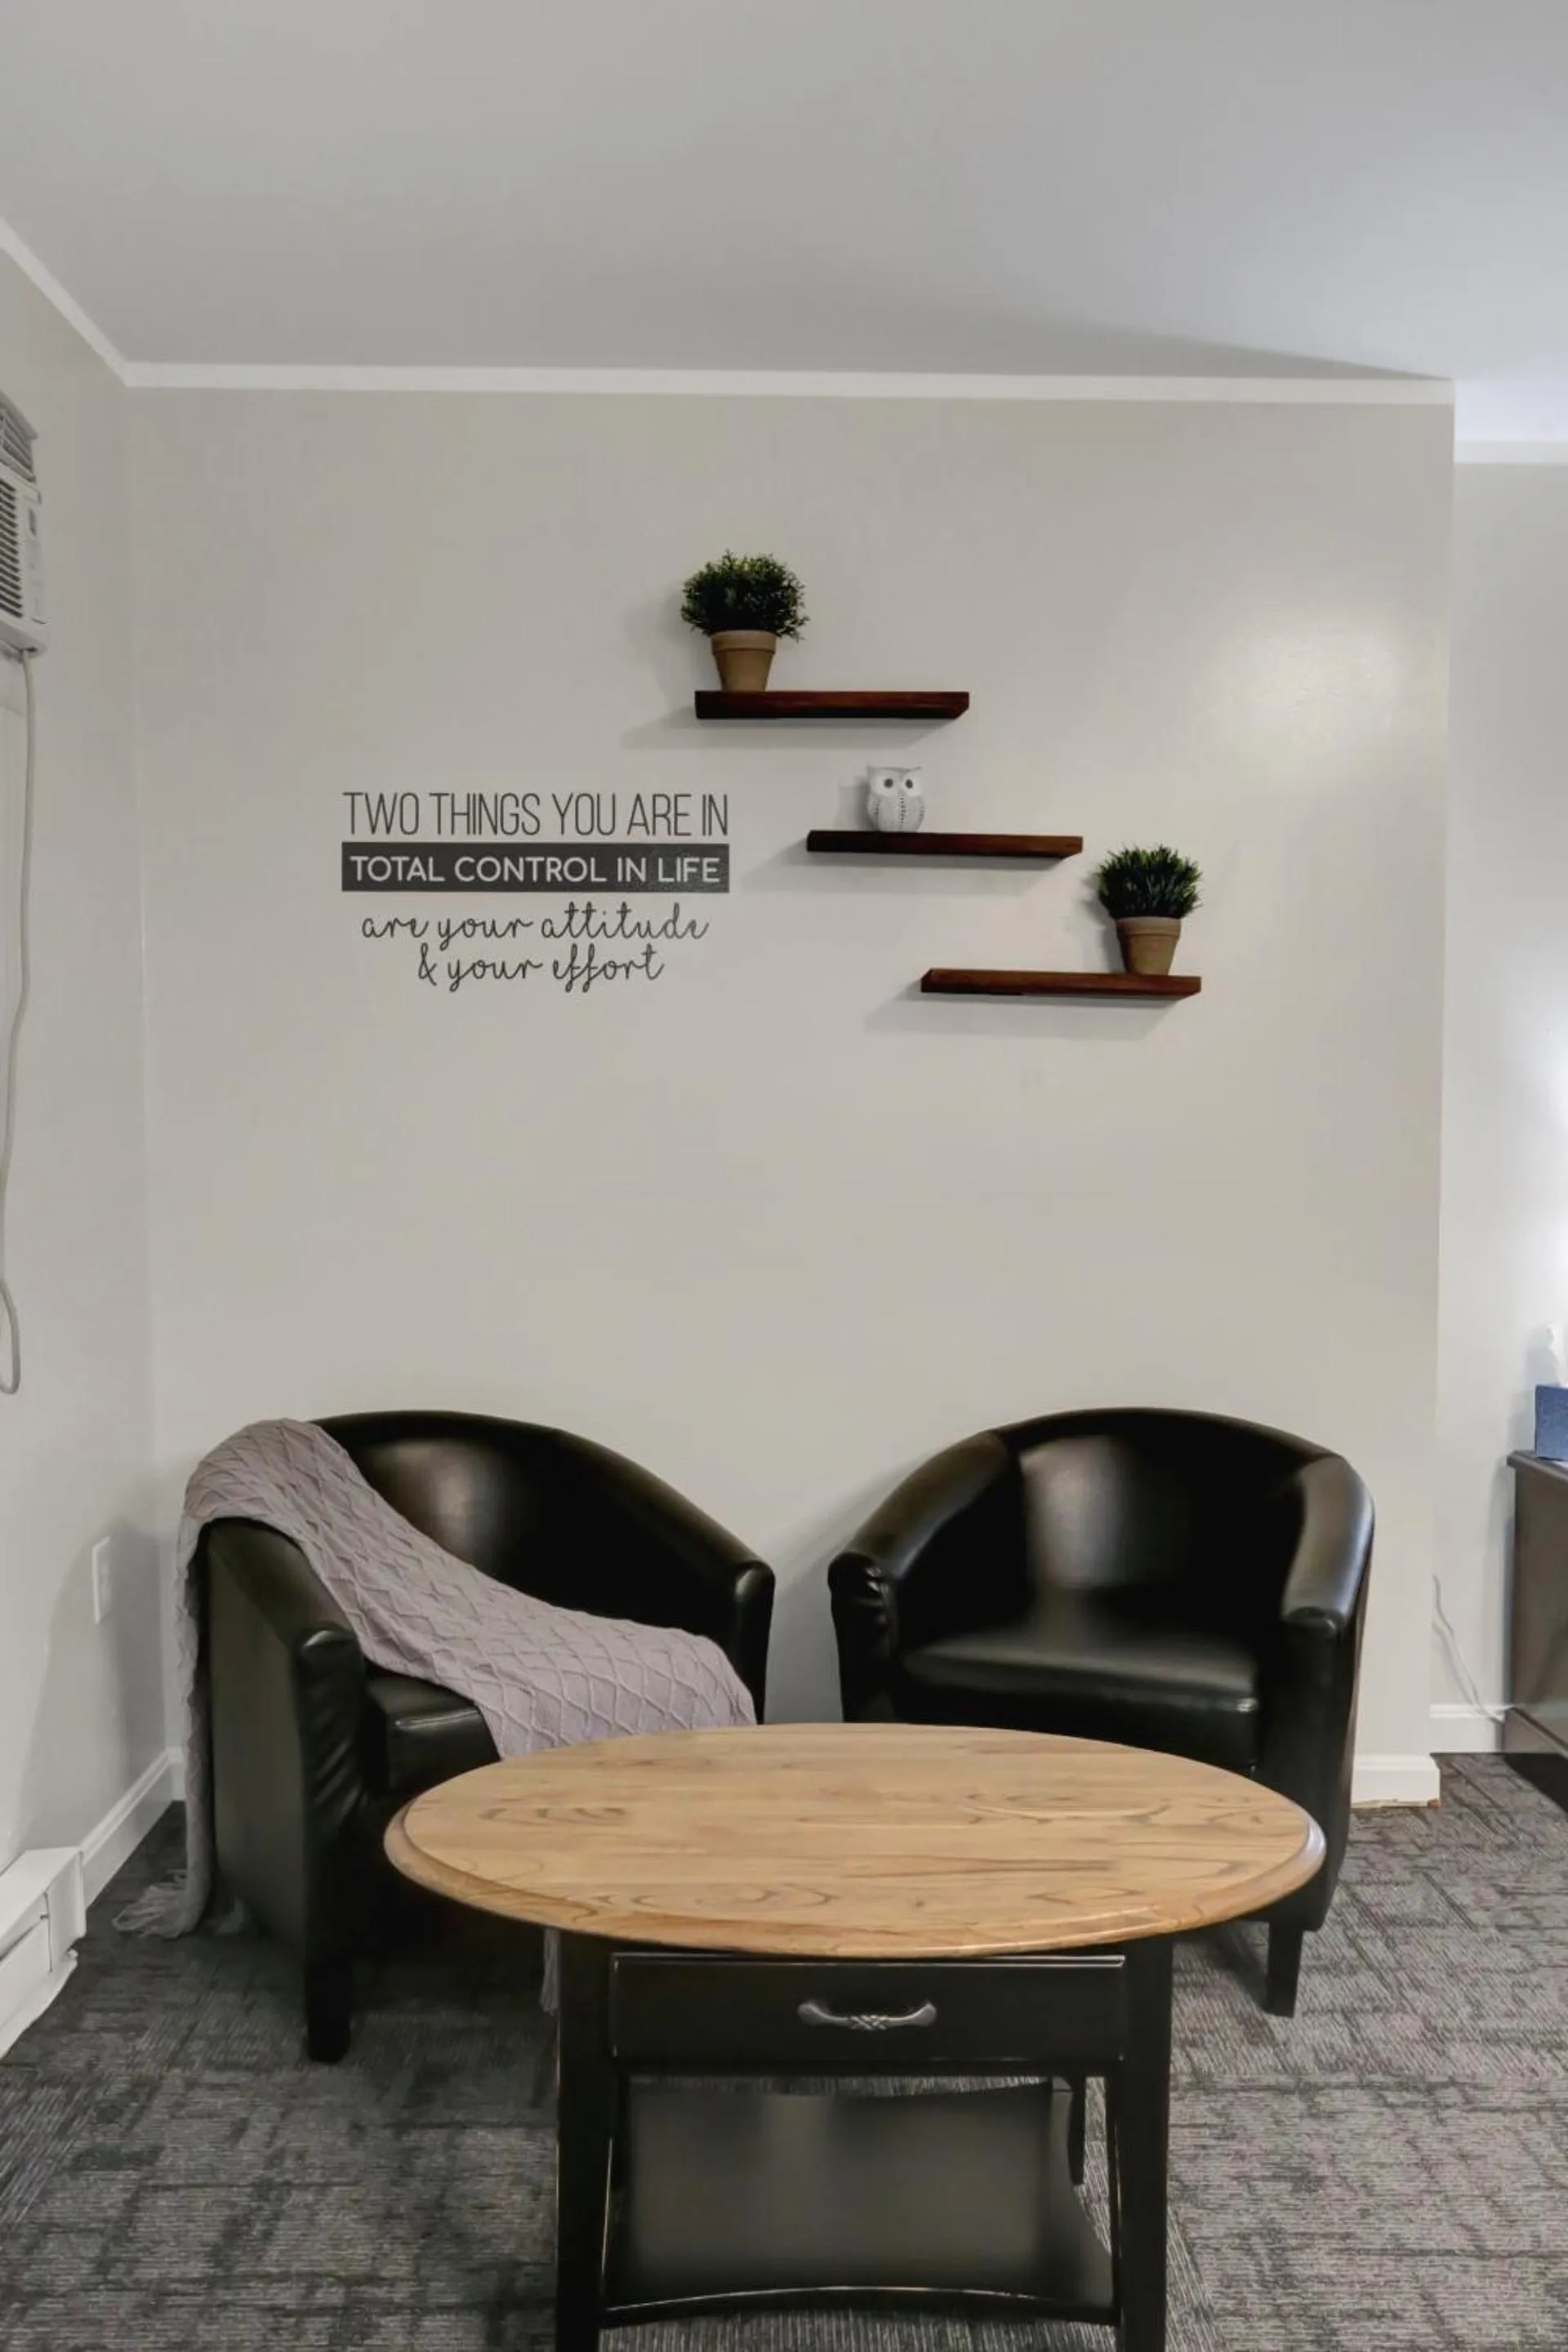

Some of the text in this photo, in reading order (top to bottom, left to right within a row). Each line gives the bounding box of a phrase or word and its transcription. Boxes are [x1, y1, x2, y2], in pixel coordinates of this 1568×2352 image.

[341, 791, 728, 837] TWO THINGS YOU ARE IN
[350, 855, 721, 883] TOTAL CONTROL IN LIFE
[361, 901, 710, 951] are your attitude
[417, 942, 666, 993] & your effort
